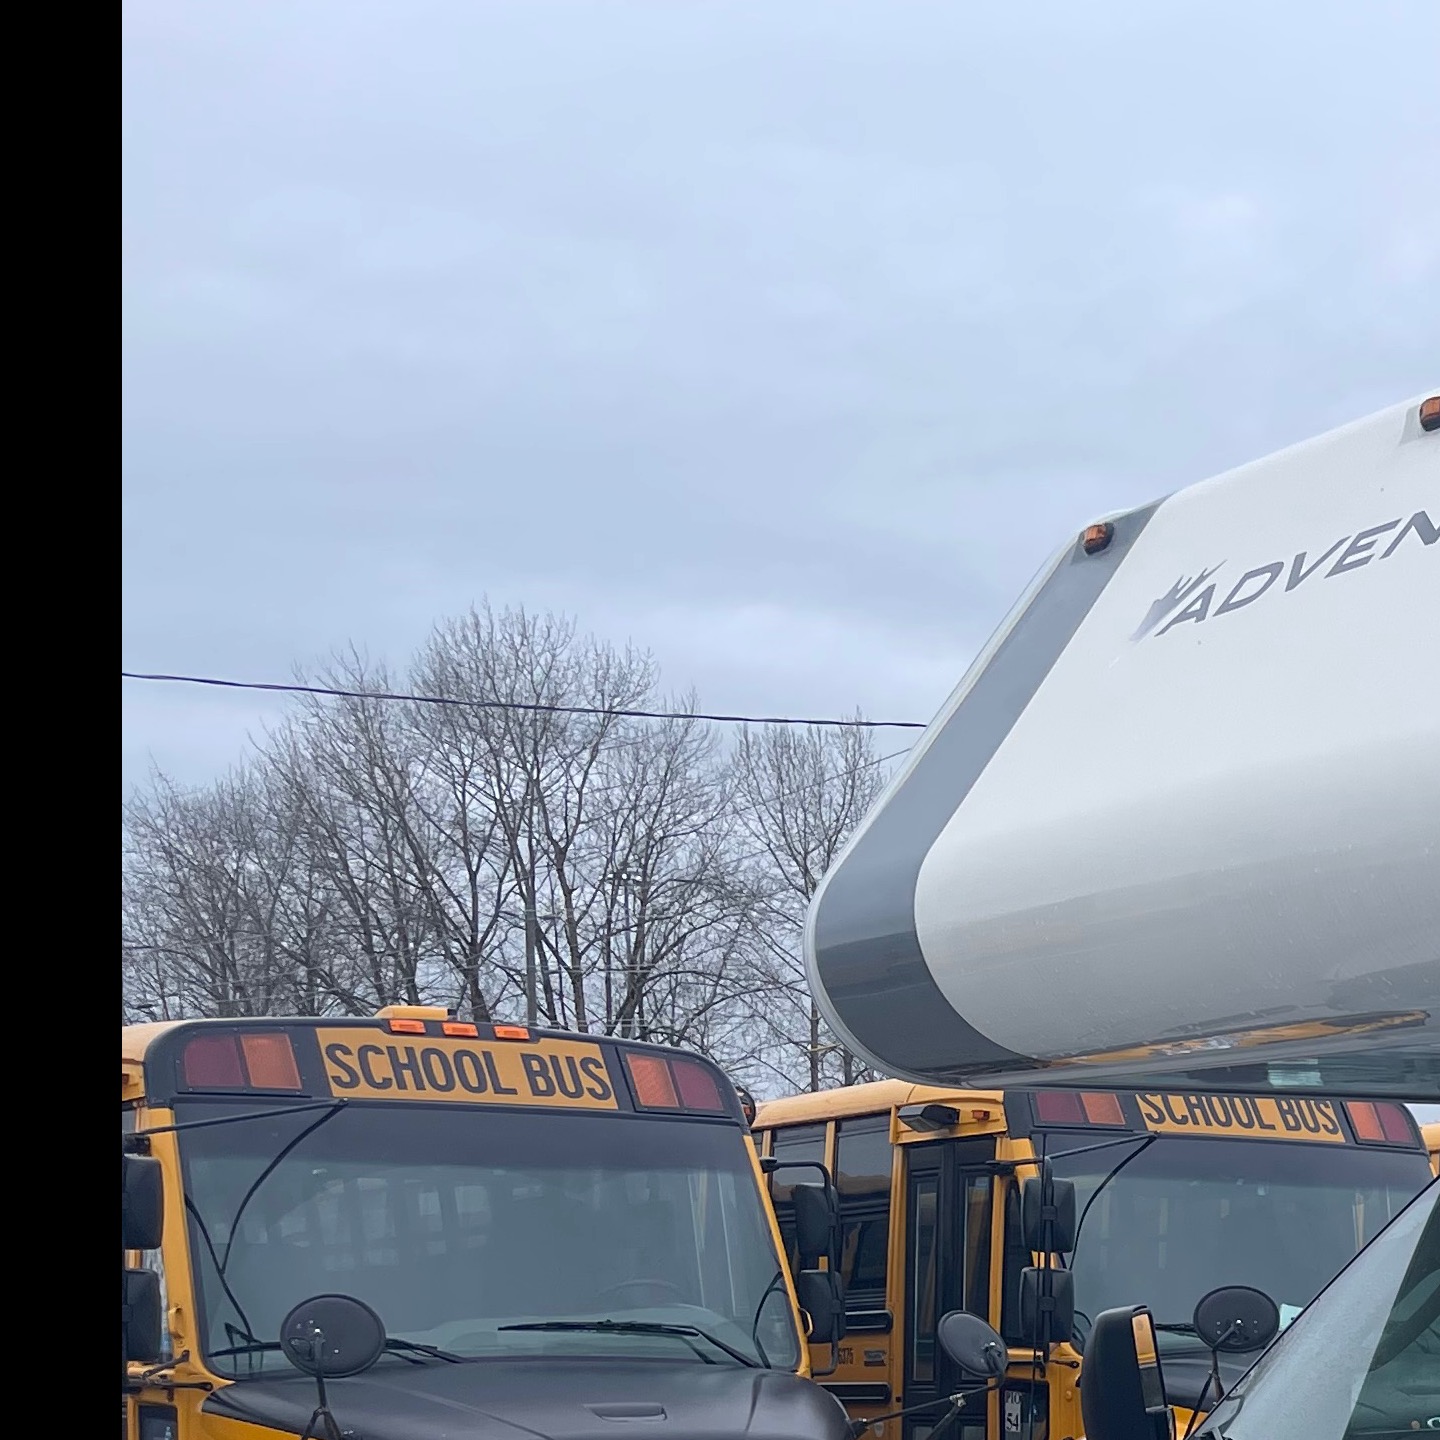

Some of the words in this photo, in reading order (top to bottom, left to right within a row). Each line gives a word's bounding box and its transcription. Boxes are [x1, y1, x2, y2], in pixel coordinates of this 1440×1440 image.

[325, 1043, 518, 1096] SCHOOL
[520, 1053, 613, 1100] BUS
[1138, 1094, 1276, 1130] SCHOOL
[1275, 1099, 1340, 1135] BUS
